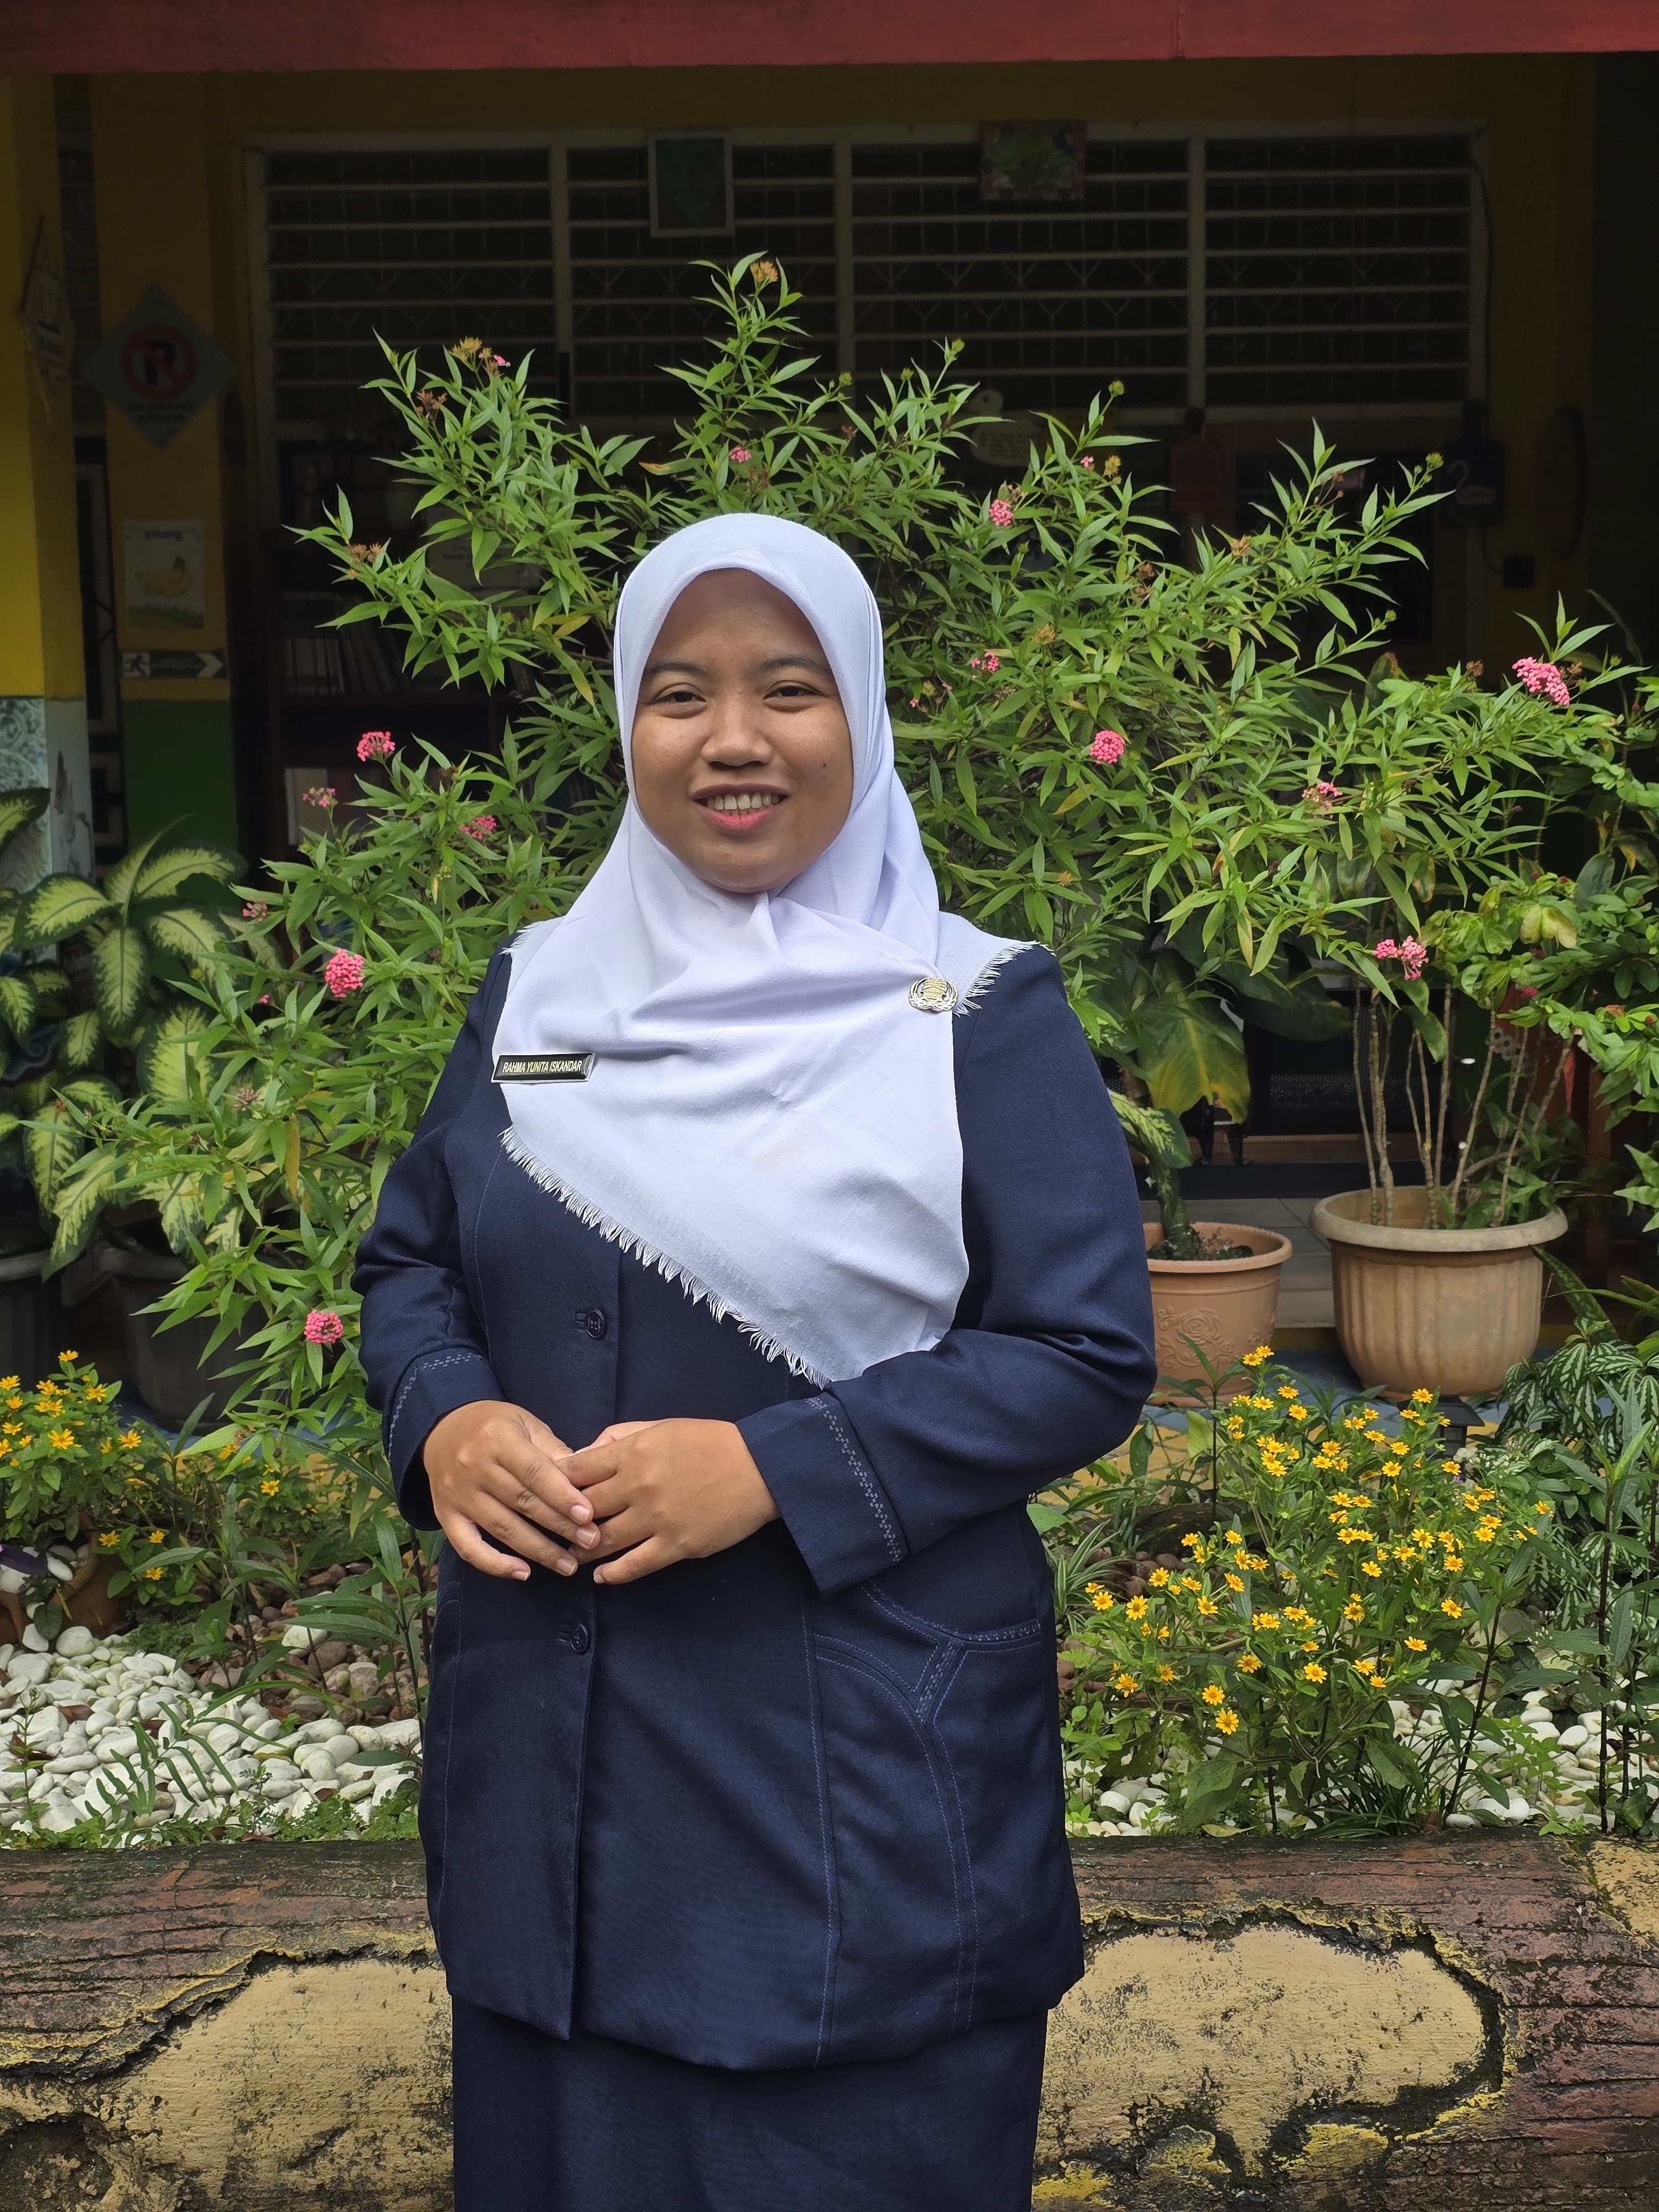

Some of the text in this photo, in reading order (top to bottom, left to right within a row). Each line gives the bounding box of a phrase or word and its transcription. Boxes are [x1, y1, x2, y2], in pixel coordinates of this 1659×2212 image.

[502, 1060, 582, 1073] RAHMA YUNITA ISKANDAR
